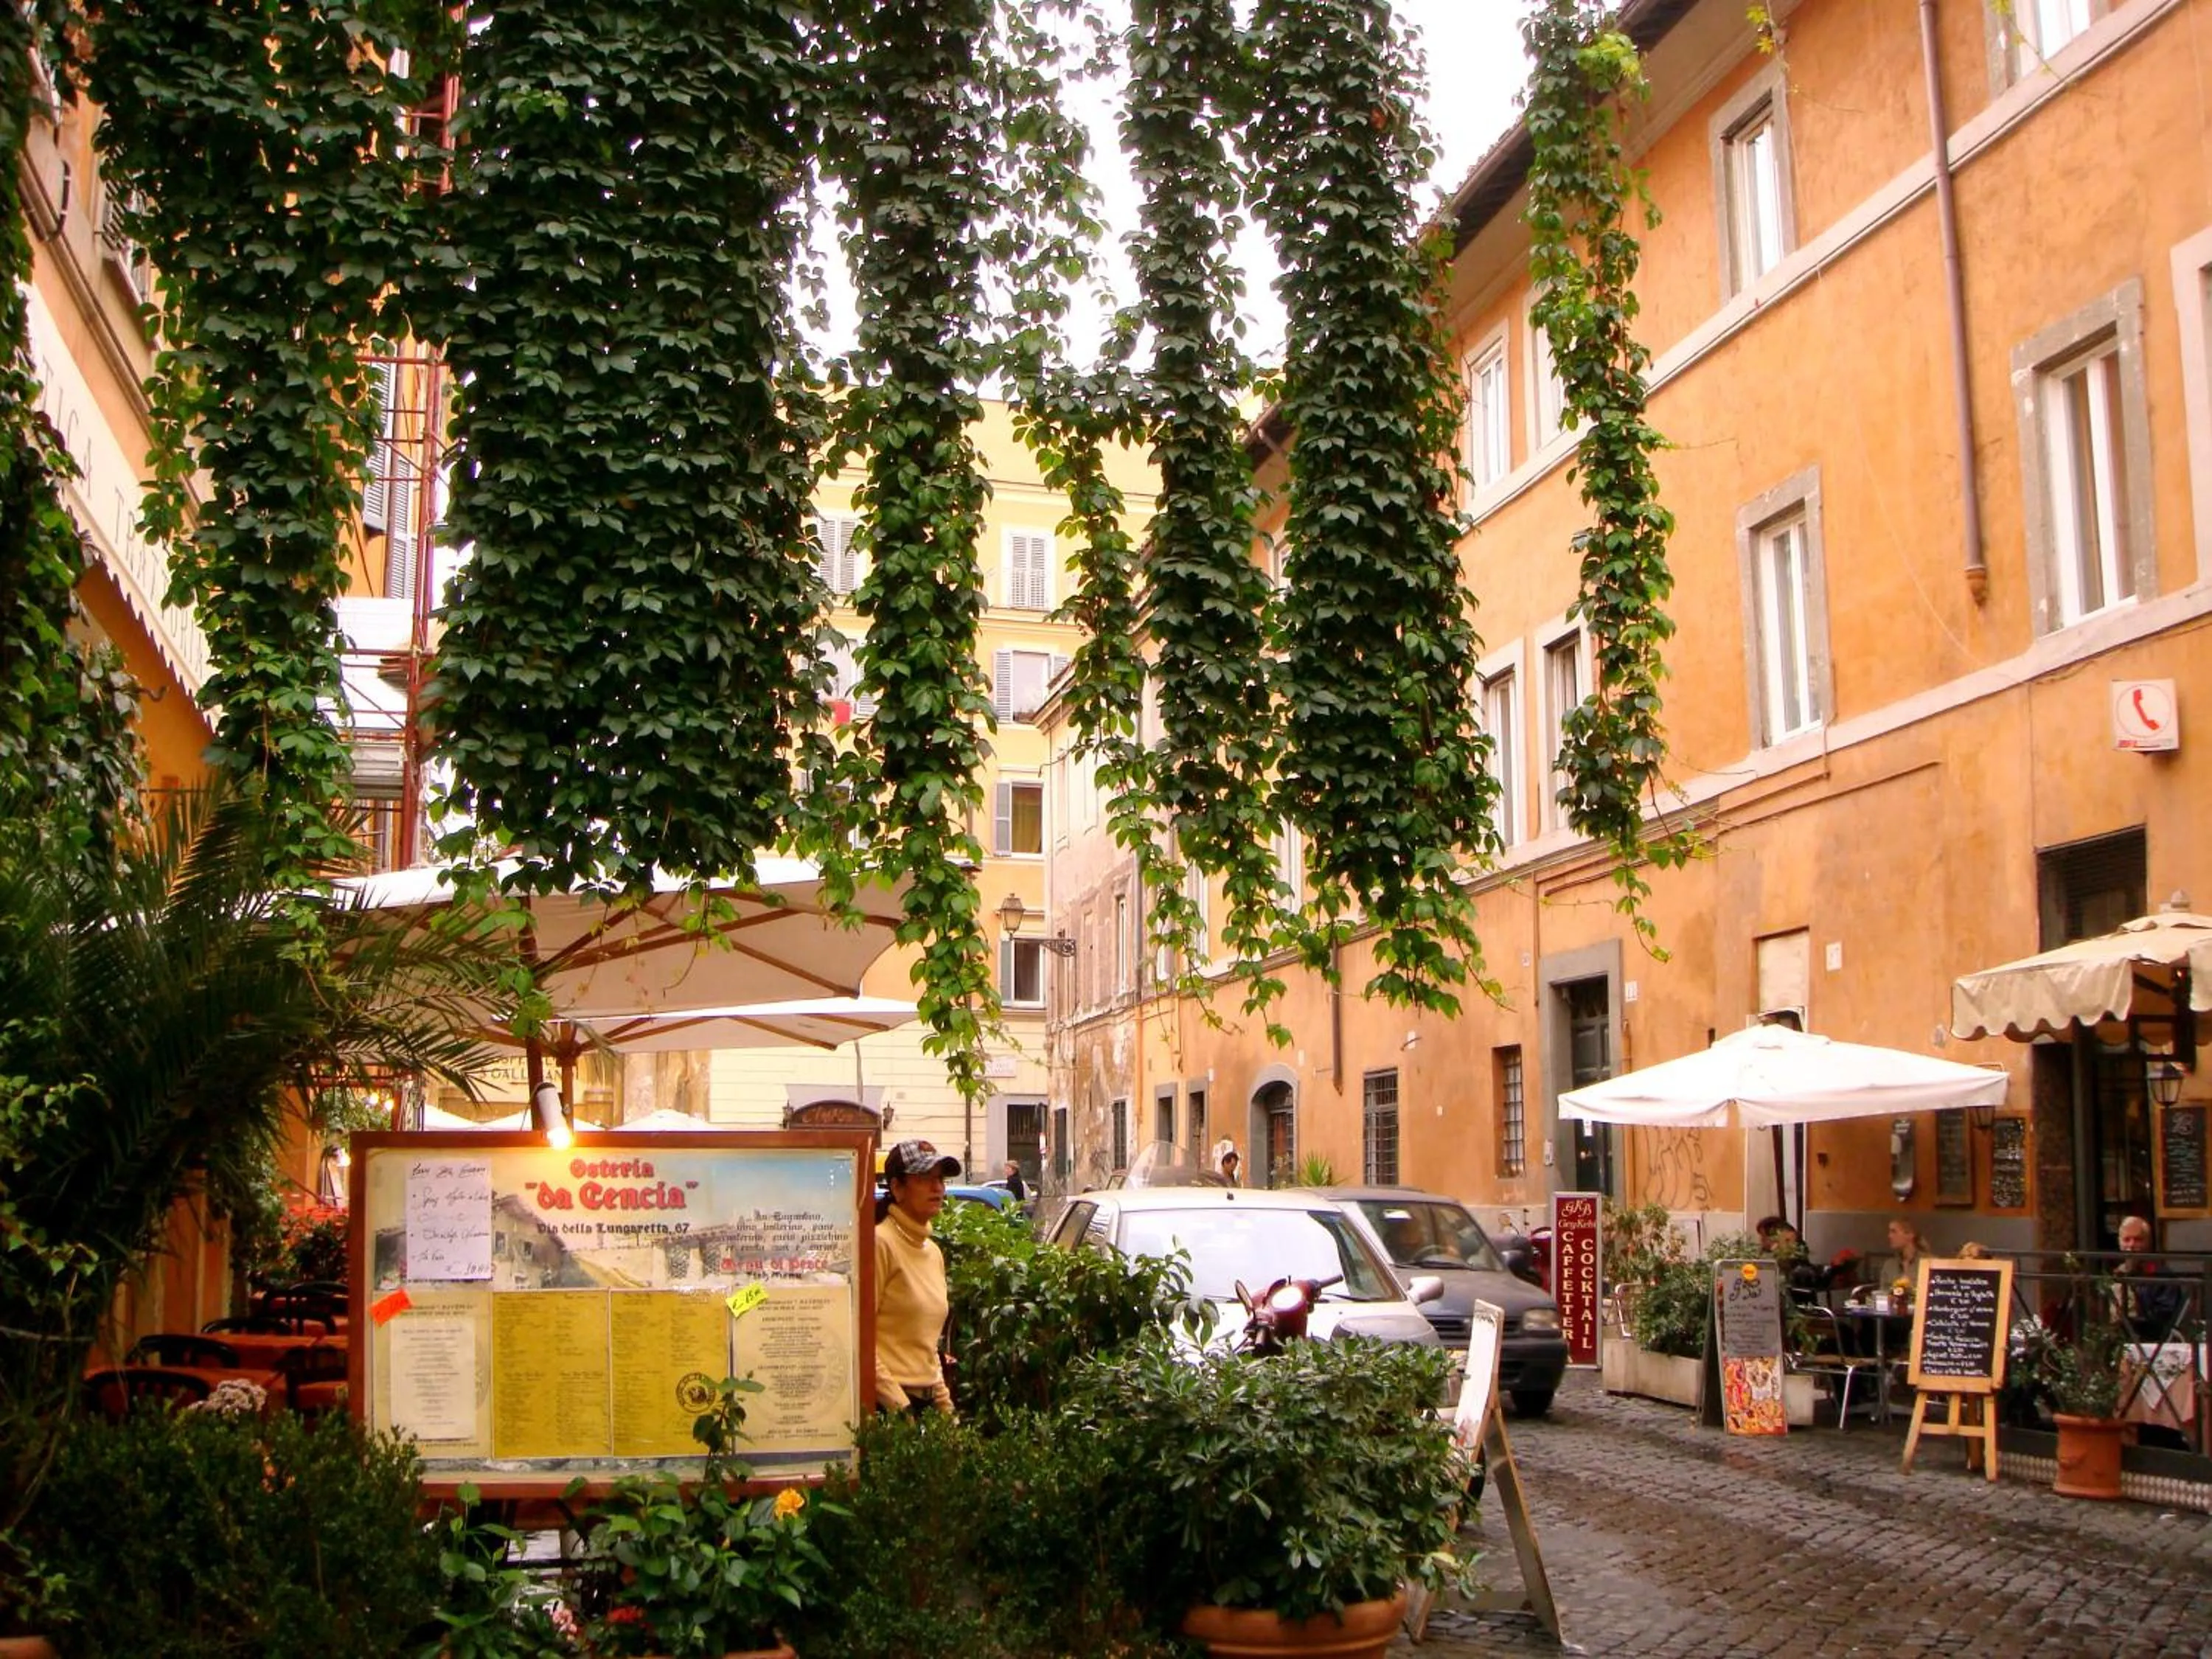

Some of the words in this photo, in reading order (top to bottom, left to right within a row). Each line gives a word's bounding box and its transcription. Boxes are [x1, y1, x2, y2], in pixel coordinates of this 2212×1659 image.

[570, 1158, 655, 1178] Osteria
[562, 1222, 593, 1234] della
[1580, 1238, 1594, 1349] COCKTAIL
